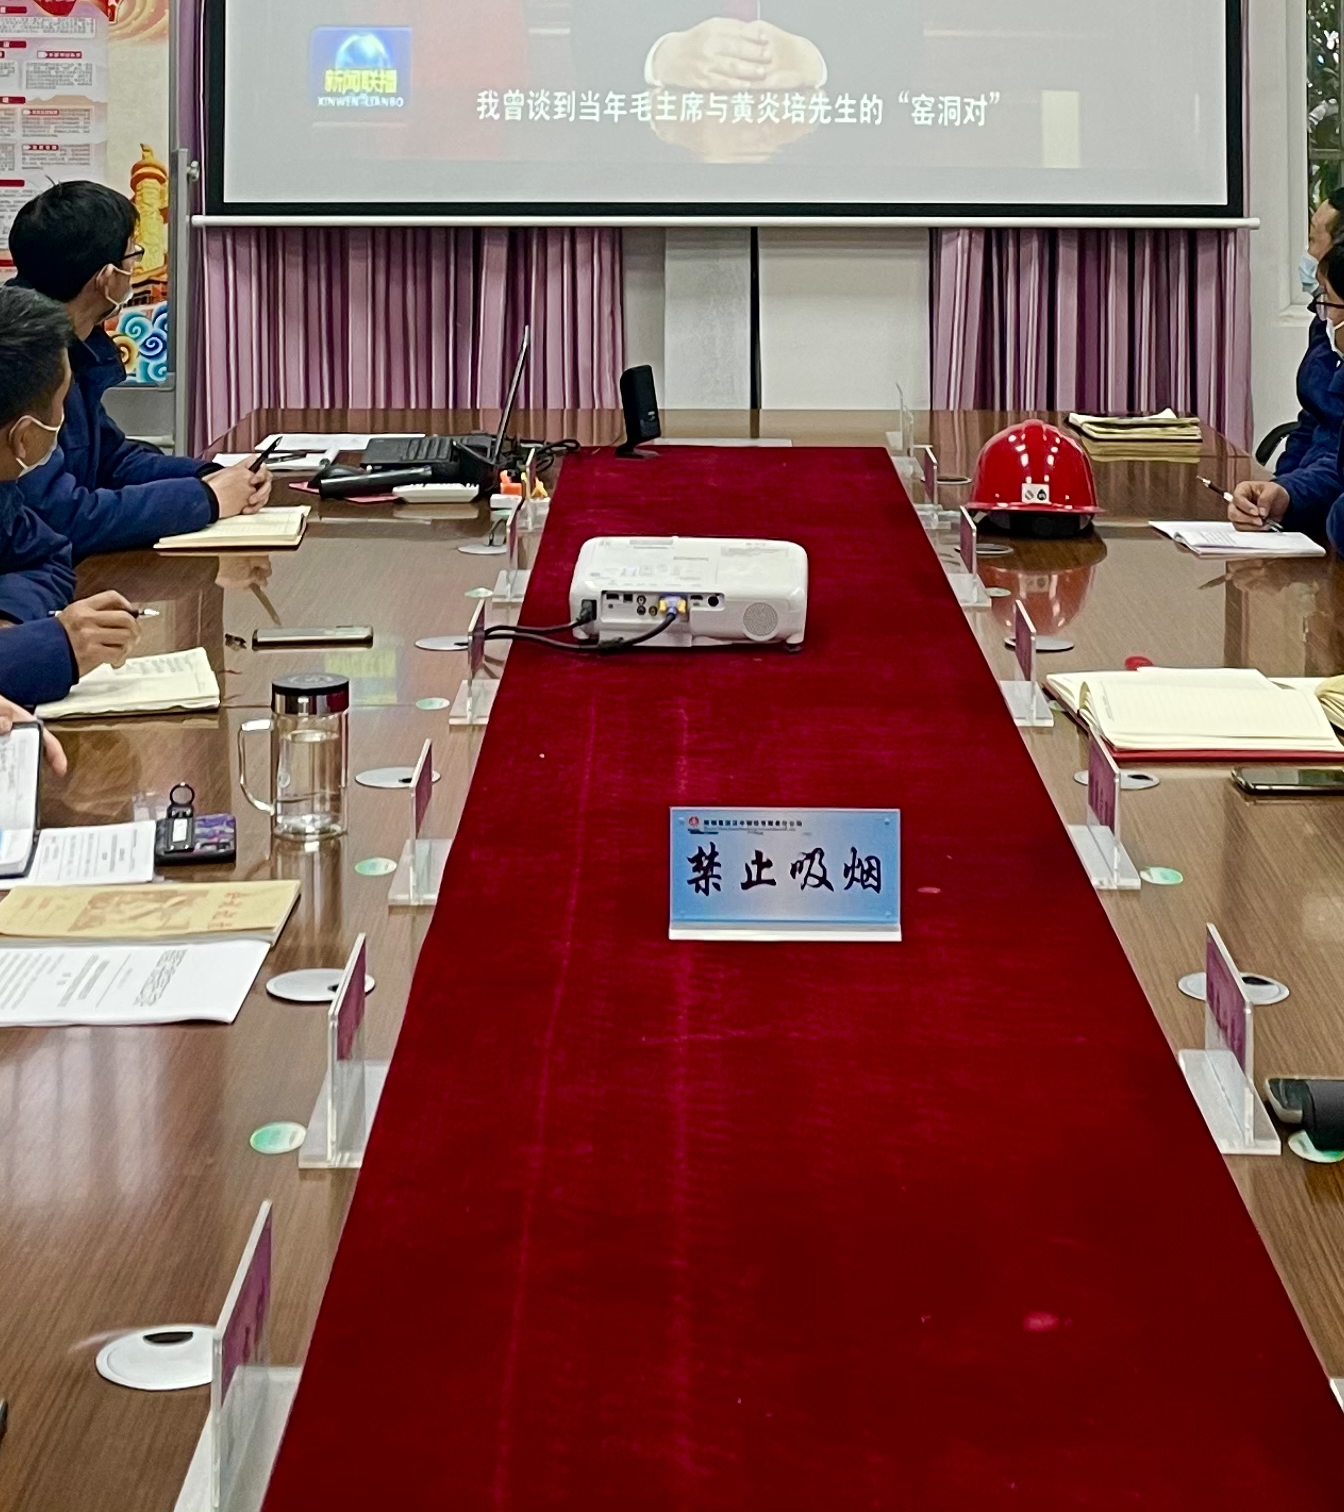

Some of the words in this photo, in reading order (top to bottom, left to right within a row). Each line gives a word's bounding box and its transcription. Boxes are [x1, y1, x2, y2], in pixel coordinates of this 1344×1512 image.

[324, 69, 397, 94] 新闻联播
[476, 90, 1002, 126] 我曾谈到当年毛主席与黄炎培先生的“窑洞对”
[686, 841, 882, 897] 禁止吸烟
